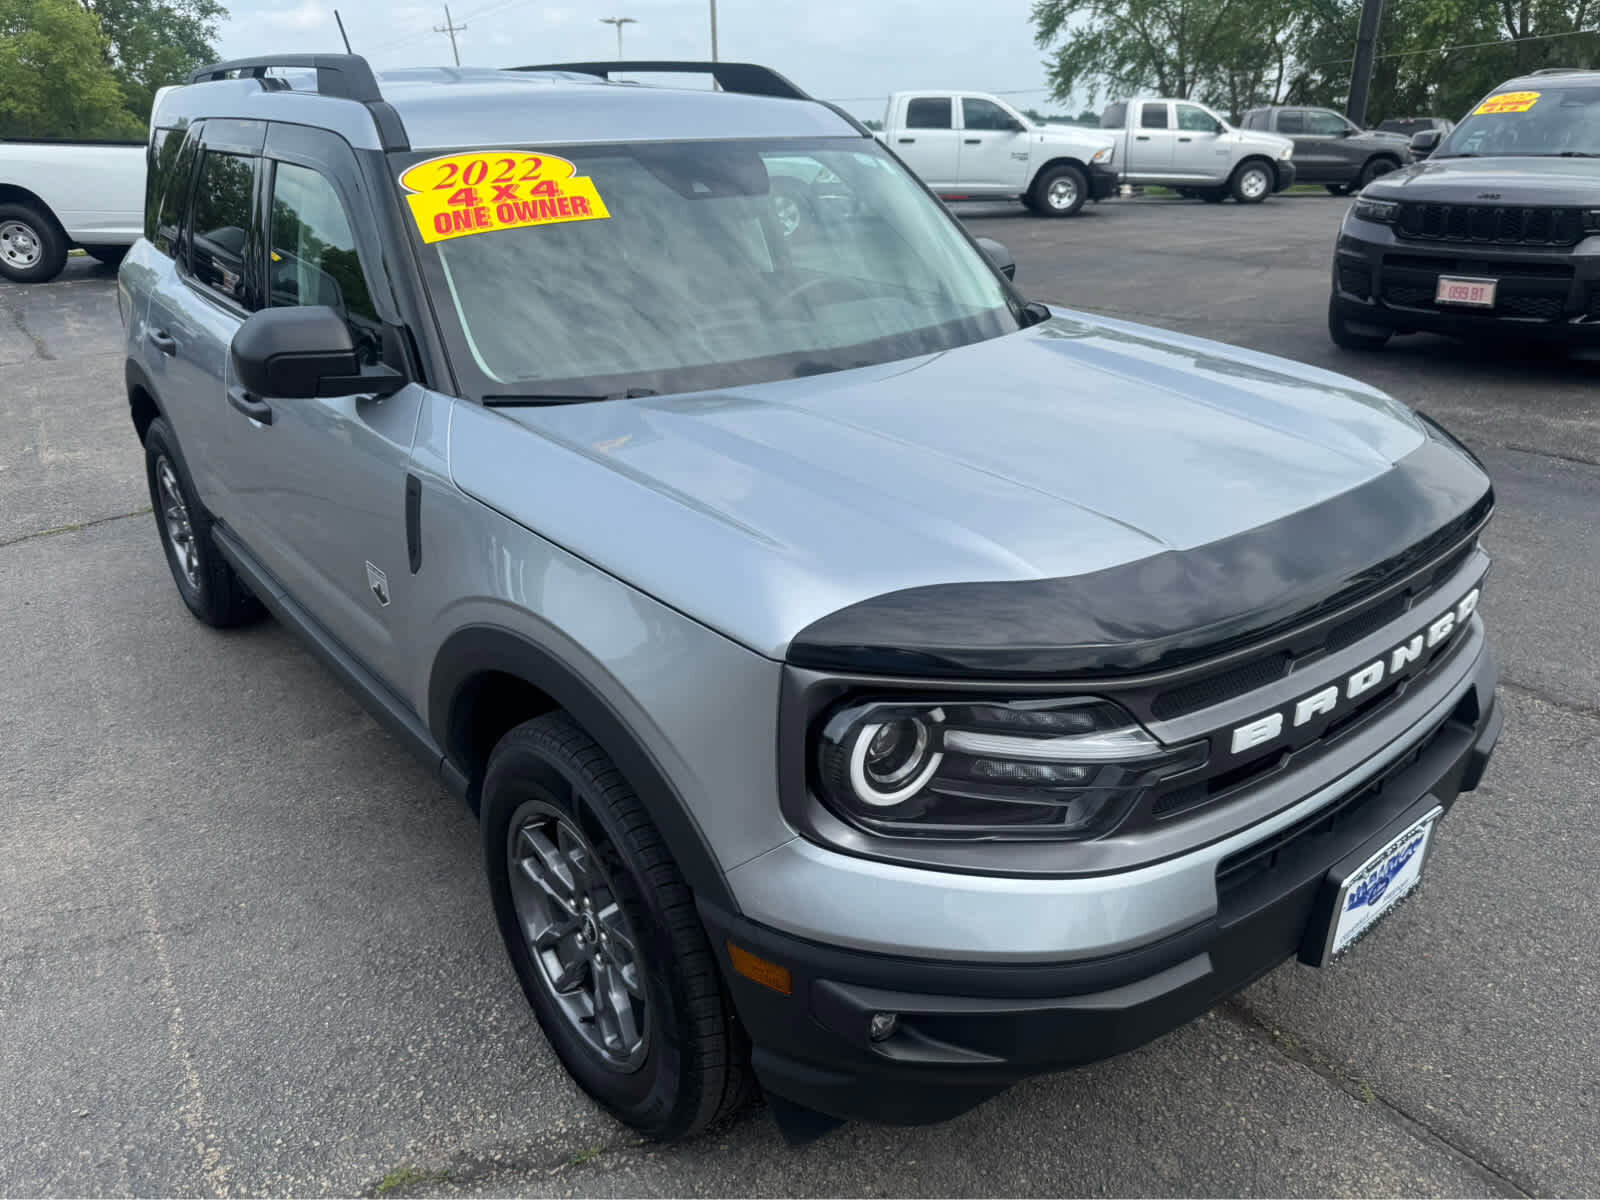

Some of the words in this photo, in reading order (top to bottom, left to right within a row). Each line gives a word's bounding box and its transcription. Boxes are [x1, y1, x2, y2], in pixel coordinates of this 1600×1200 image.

[432, 157, 543, 190] 2022
[433, 207, 493, 235] ONE
[496, 196, 593, 225] OWNER
[1230, 588, 1480, 755] BRONCO
